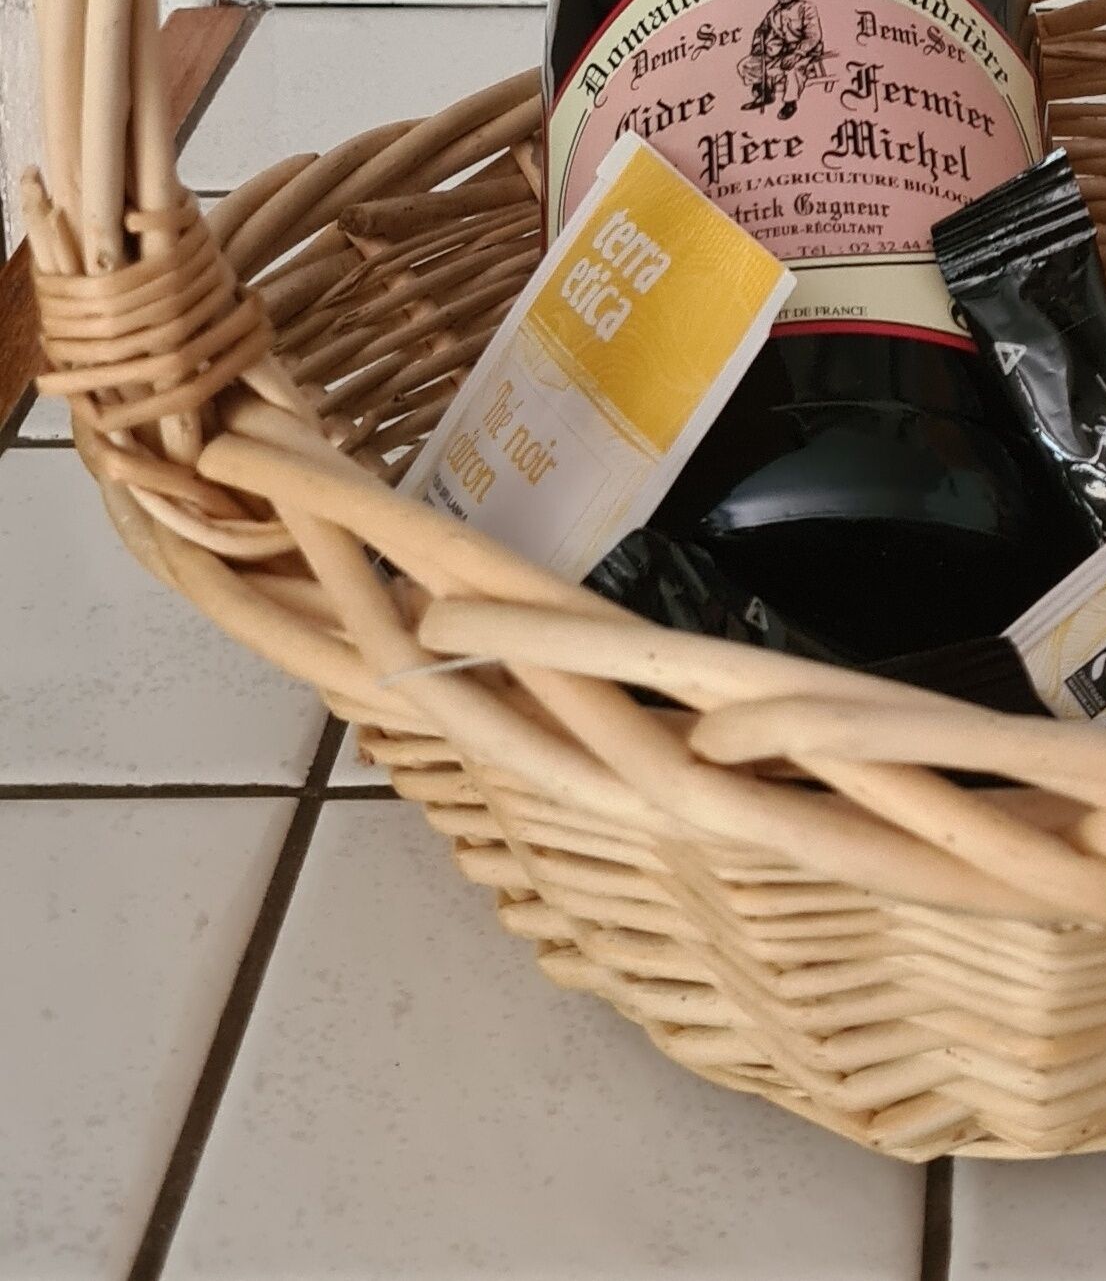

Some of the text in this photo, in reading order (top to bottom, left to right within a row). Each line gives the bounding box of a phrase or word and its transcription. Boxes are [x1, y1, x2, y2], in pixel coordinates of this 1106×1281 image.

[630, 9, 967, 90] Demi-Sec Demi-Sec
[840, 61, 995, 137] Fermier
[698, 119, 971, 186] Père Michel
[718, 182, 742, 198] DE
[746, 172, 899, 192] L'AGRICULTURE
[794, 192, 891, 221] Gagneur
[592, 208, 672, 295] terra
[849, 241, 869, 253] 02
[878, 240, 896, 252] 32
[902, 239, 921, 251] 44
[561, 257, 633, 343] etica
[794, 308, 812, 318] DE
[815, 306, 868, 317] FRANCE
[503, 423, 557, 487] noir
